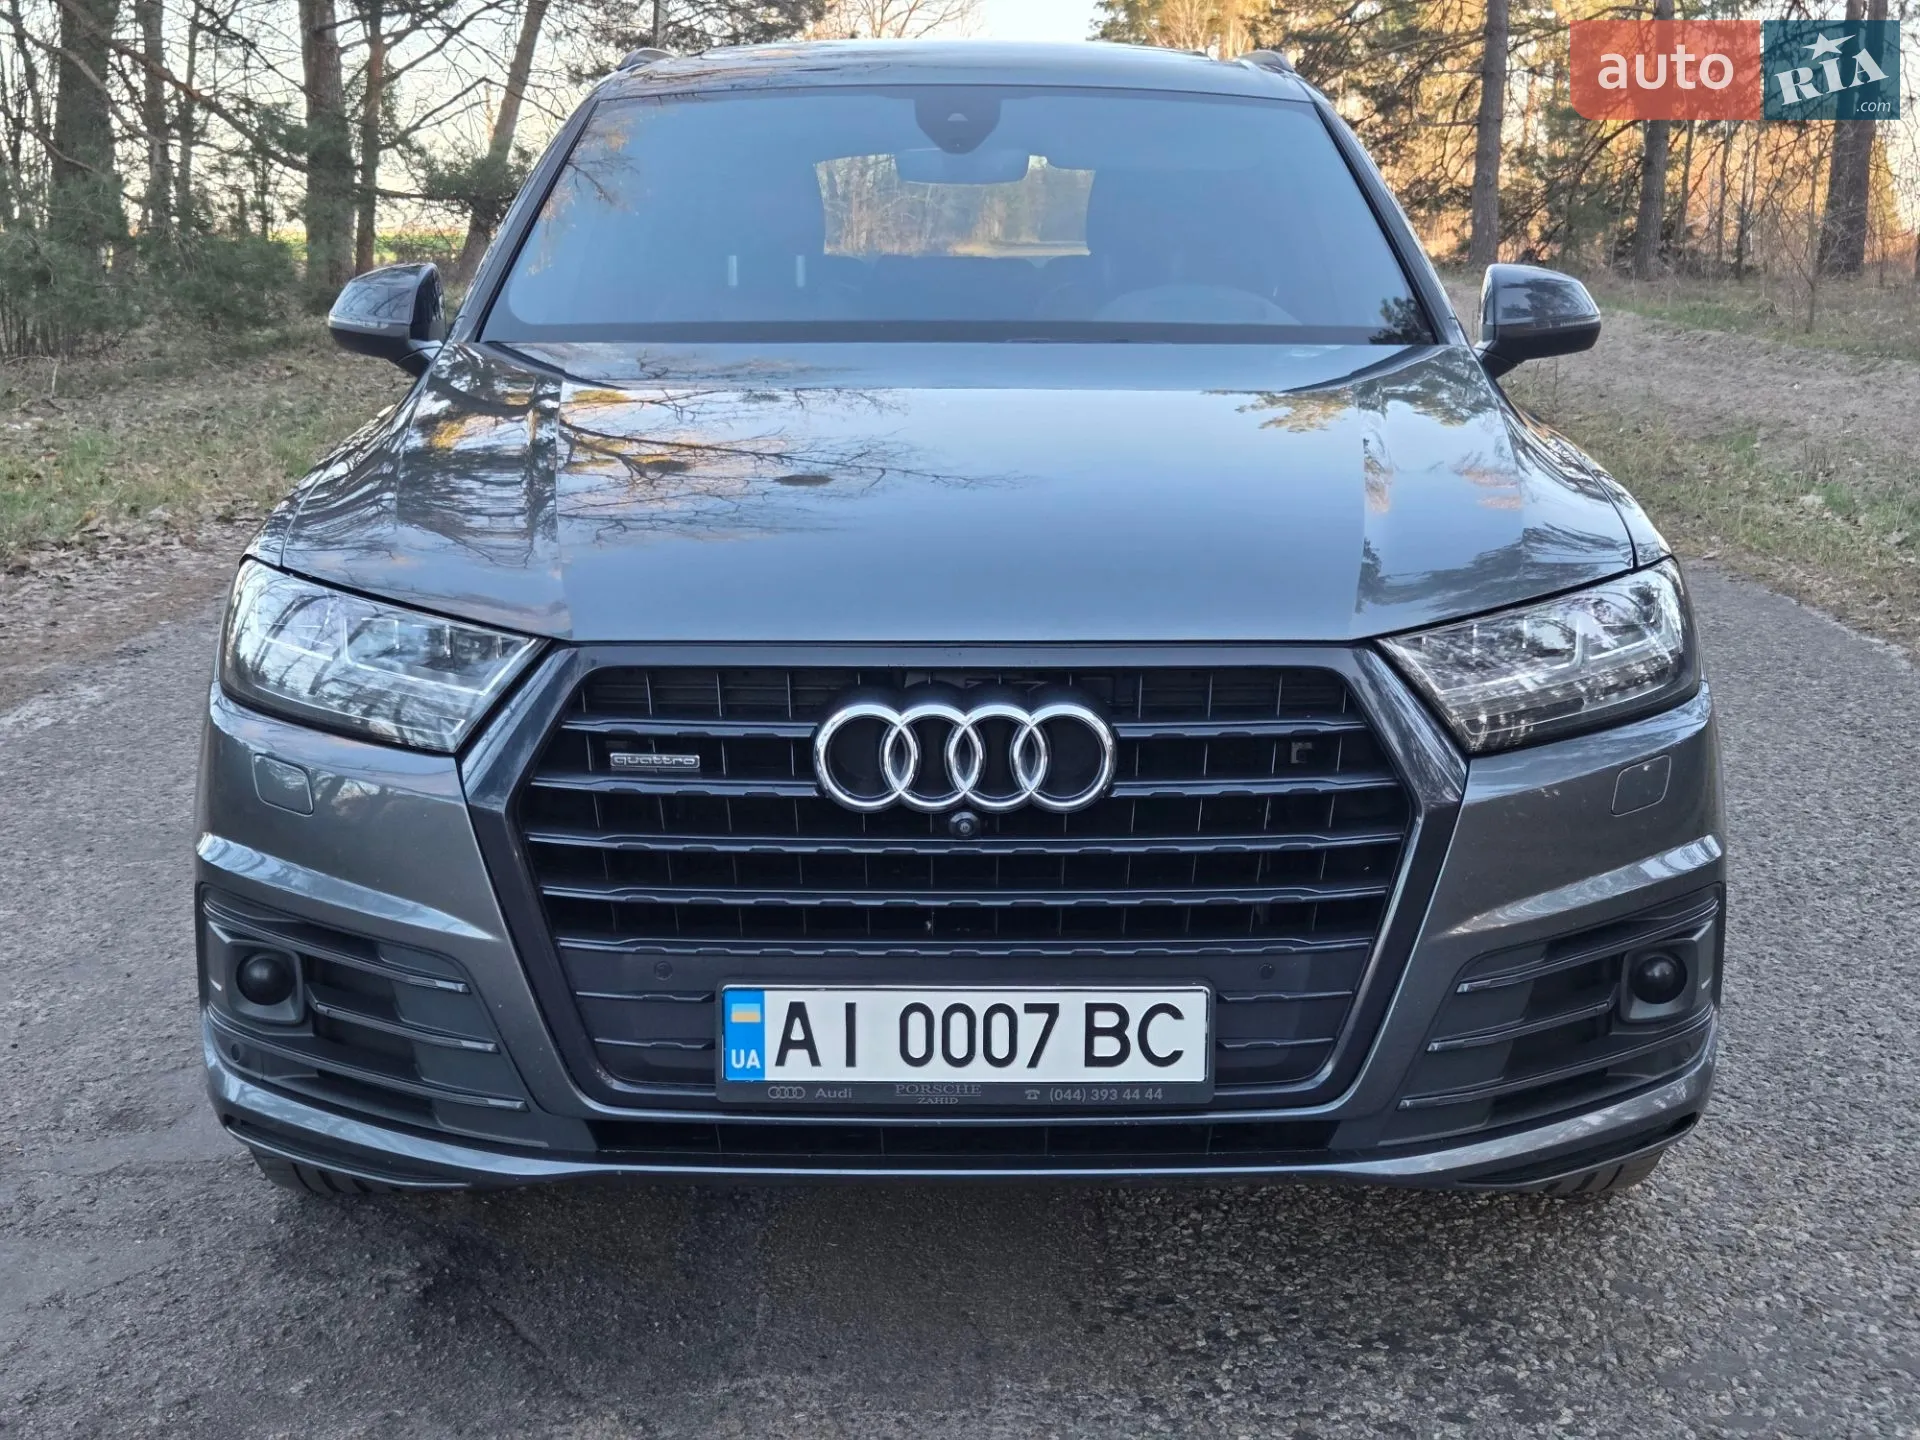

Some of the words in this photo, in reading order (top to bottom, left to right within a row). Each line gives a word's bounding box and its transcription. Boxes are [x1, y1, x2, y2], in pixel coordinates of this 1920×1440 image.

[613, 756, 696, 766] quattro
[774, 1001, 857, 1068] AI
[899, 1002, 1060, 1068] 0007
[1084, 1002, 1185, 1068] BC
[731, 1048, 761, 1069] UA
[814, 1088, 852, 1099] Audi
[895, 1084, 982, 1095] PORSCHE
[1050, 1088, 1086, 1102] (044)
[1091, 1089, 1118, 1100] 393
[1122, 1089, 1140, 1100] 44
[1145, 1089, 1163, 1100] 44
